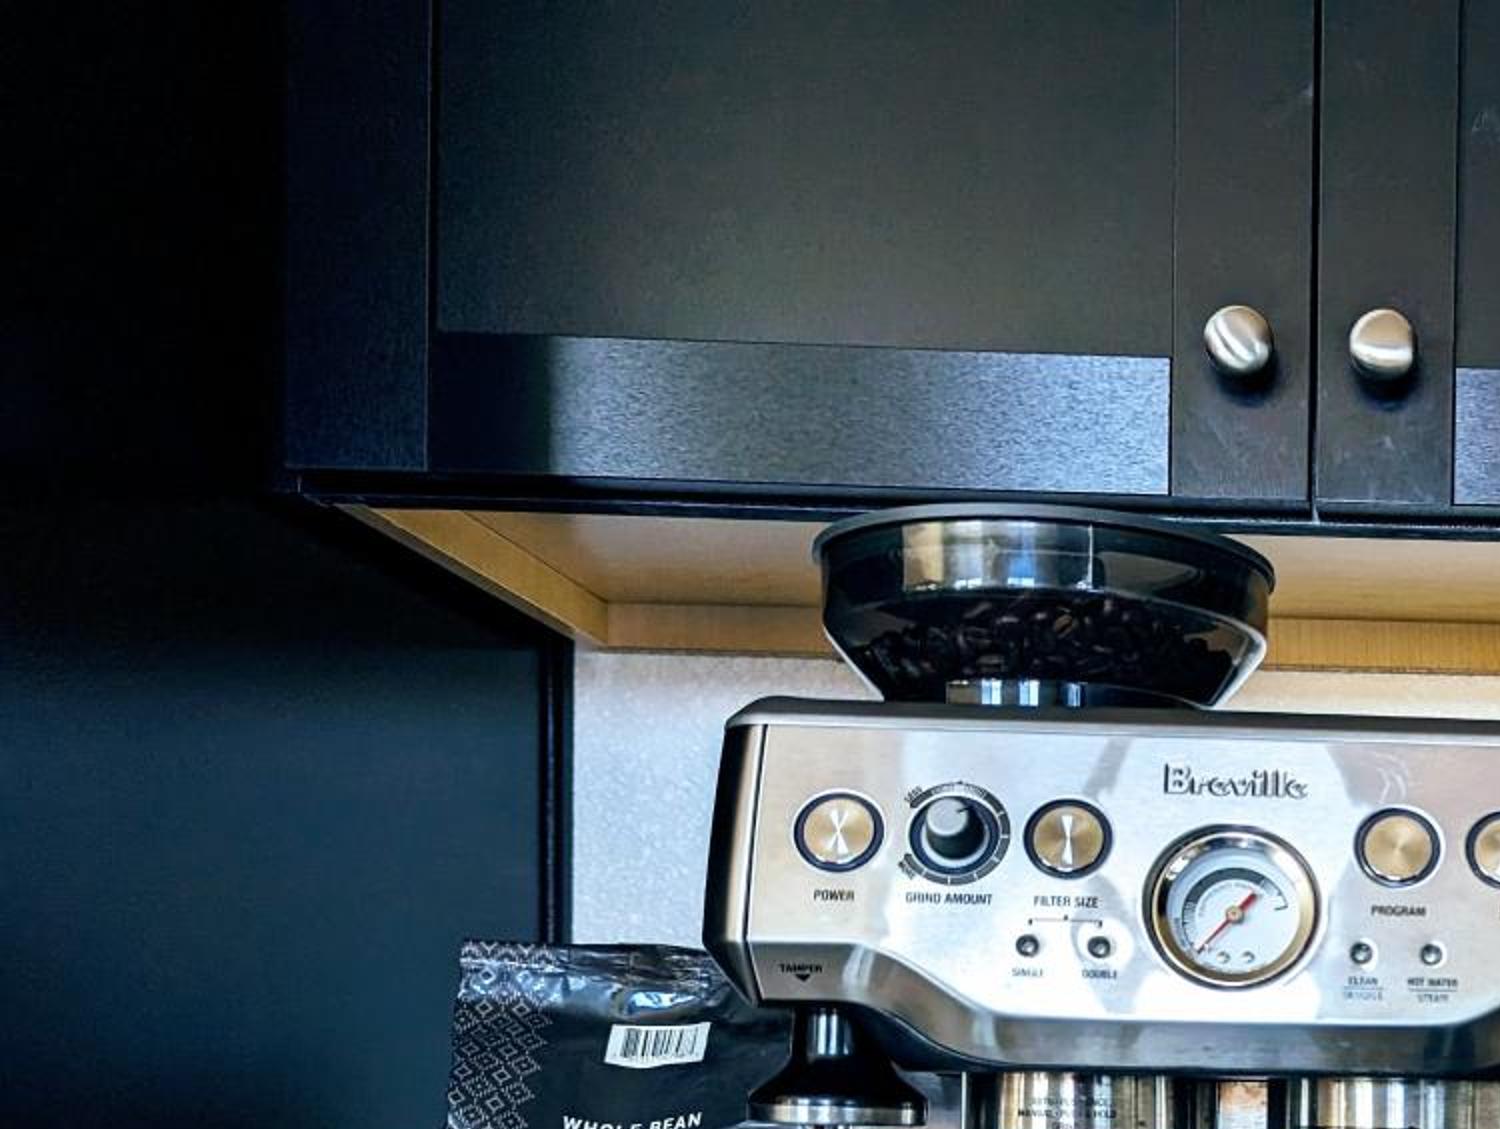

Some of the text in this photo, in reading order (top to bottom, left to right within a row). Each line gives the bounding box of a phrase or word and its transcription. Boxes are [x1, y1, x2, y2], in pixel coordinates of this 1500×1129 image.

[1164, 763, 1309, 799] Breville
[813, 889, 855, 901] POWER
[905, 892, 992, 905] GRIND AMOUNT
[1033, 895, 1099, 908] FILTER SIZE
[1371, 905, 1426, 916] PROGRAM
[779, 963, 823, 973] TAMPER
